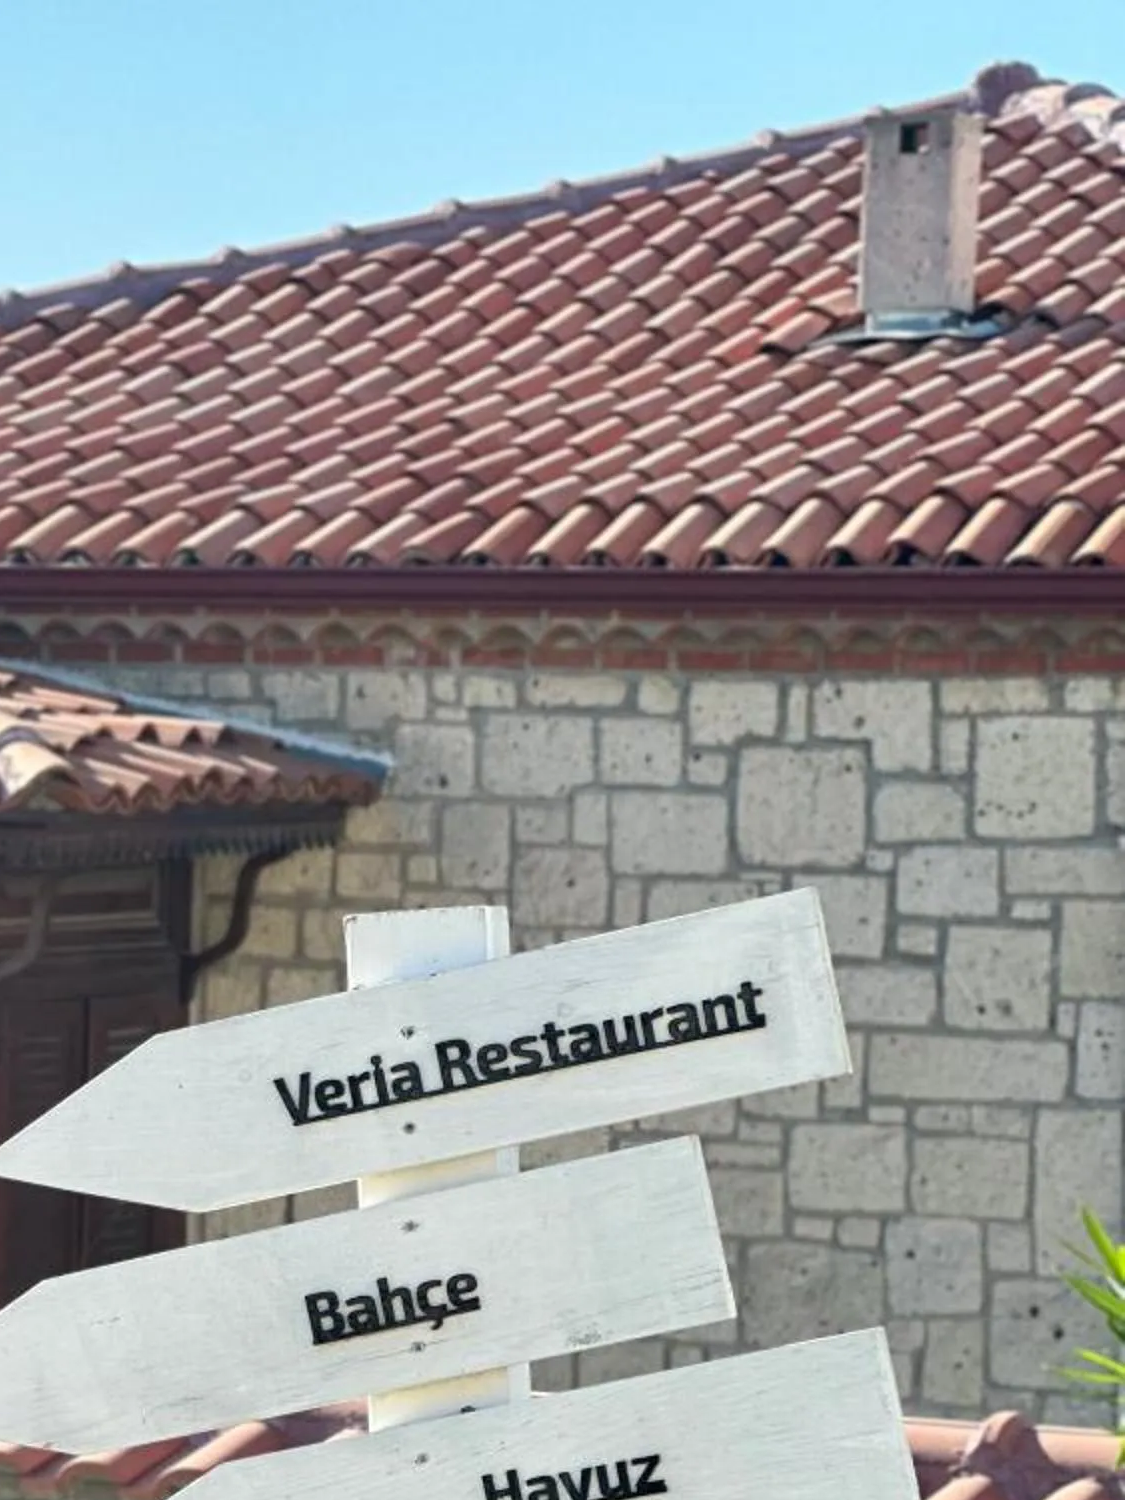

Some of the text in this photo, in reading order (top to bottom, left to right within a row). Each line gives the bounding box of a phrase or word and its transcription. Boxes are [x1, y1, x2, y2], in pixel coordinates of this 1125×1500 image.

[273, 981, 767, 1127] Veria Restaurant
[304, 1273, 481, 1346] Bahçe
